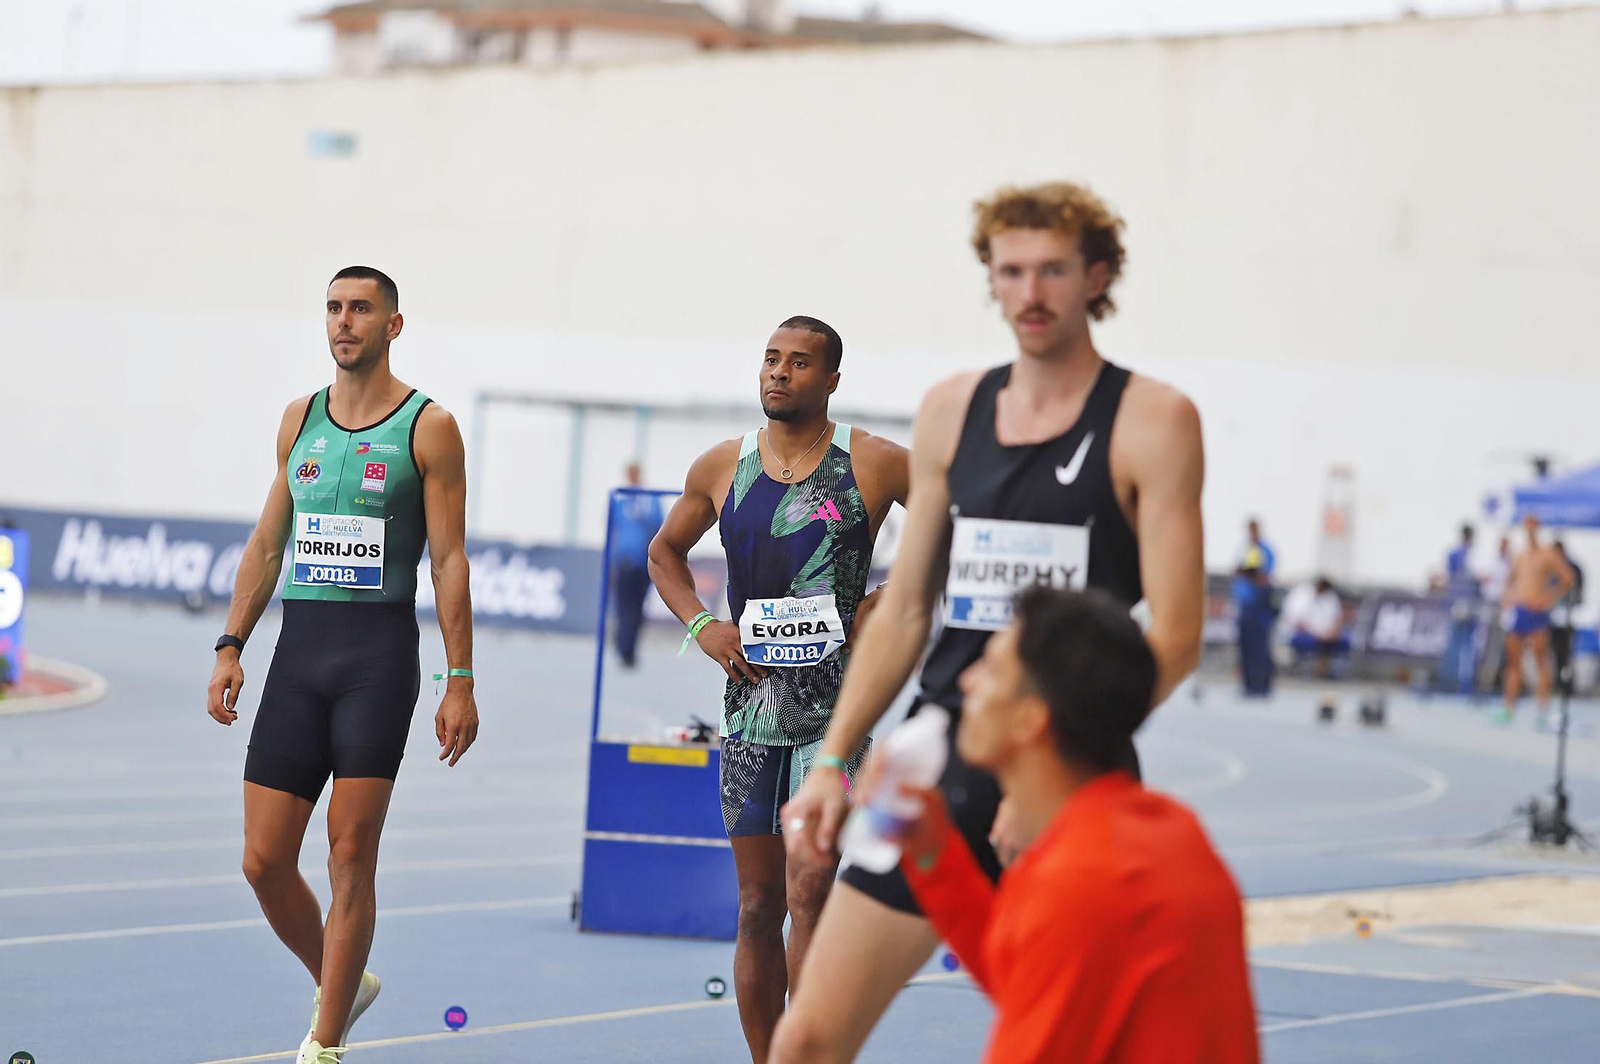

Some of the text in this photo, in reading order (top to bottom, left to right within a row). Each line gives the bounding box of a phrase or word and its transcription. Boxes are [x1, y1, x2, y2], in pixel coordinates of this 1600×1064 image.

[52, 517, 213, 593] Huelva
[297, 540, 381, 558] TORRIJOS
[752, 621, 830, 638] EVORA
